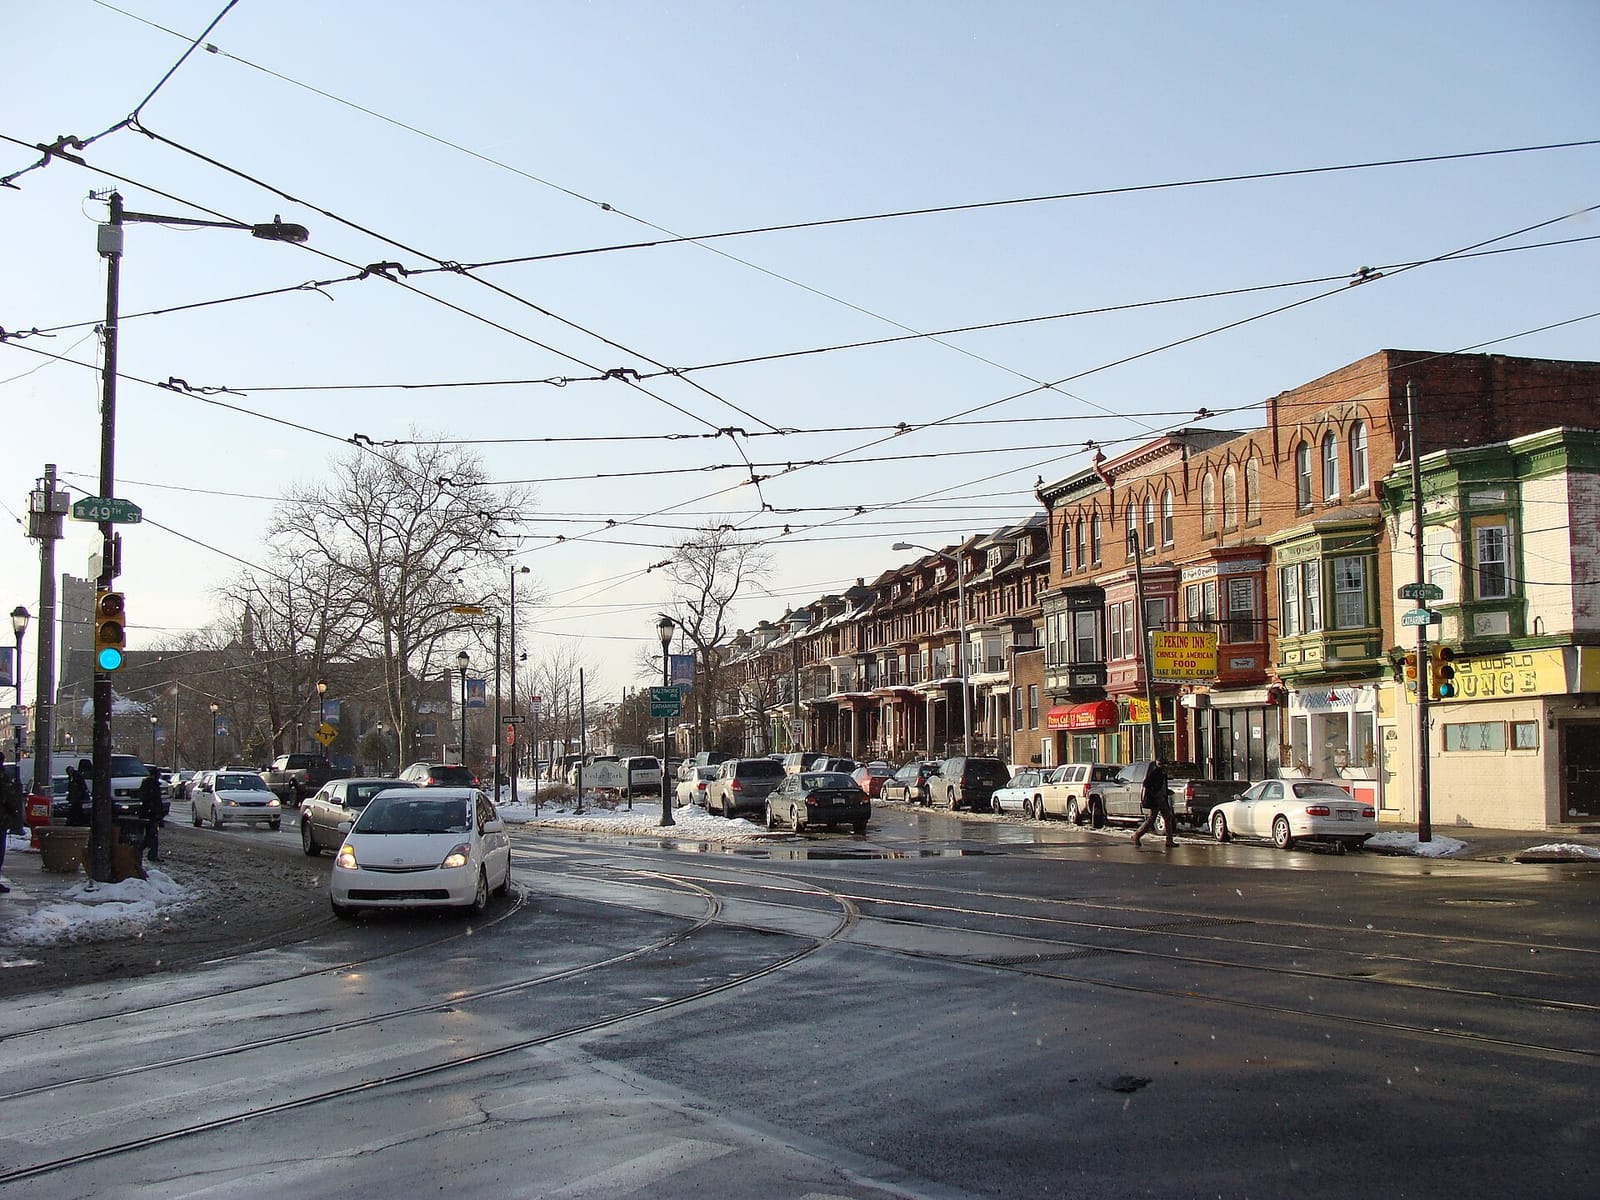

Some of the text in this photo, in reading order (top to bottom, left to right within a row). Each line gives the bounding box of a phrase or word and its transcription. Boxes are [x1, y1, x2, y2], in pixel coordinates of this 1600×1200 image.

[89, 506, 140, 522] 49TH ST
[1164, 636, 1205, 649] PEKING INN
[1173, 660, 1197, 668] FOOD
[1480, 654, 1534, 671] WORLD
